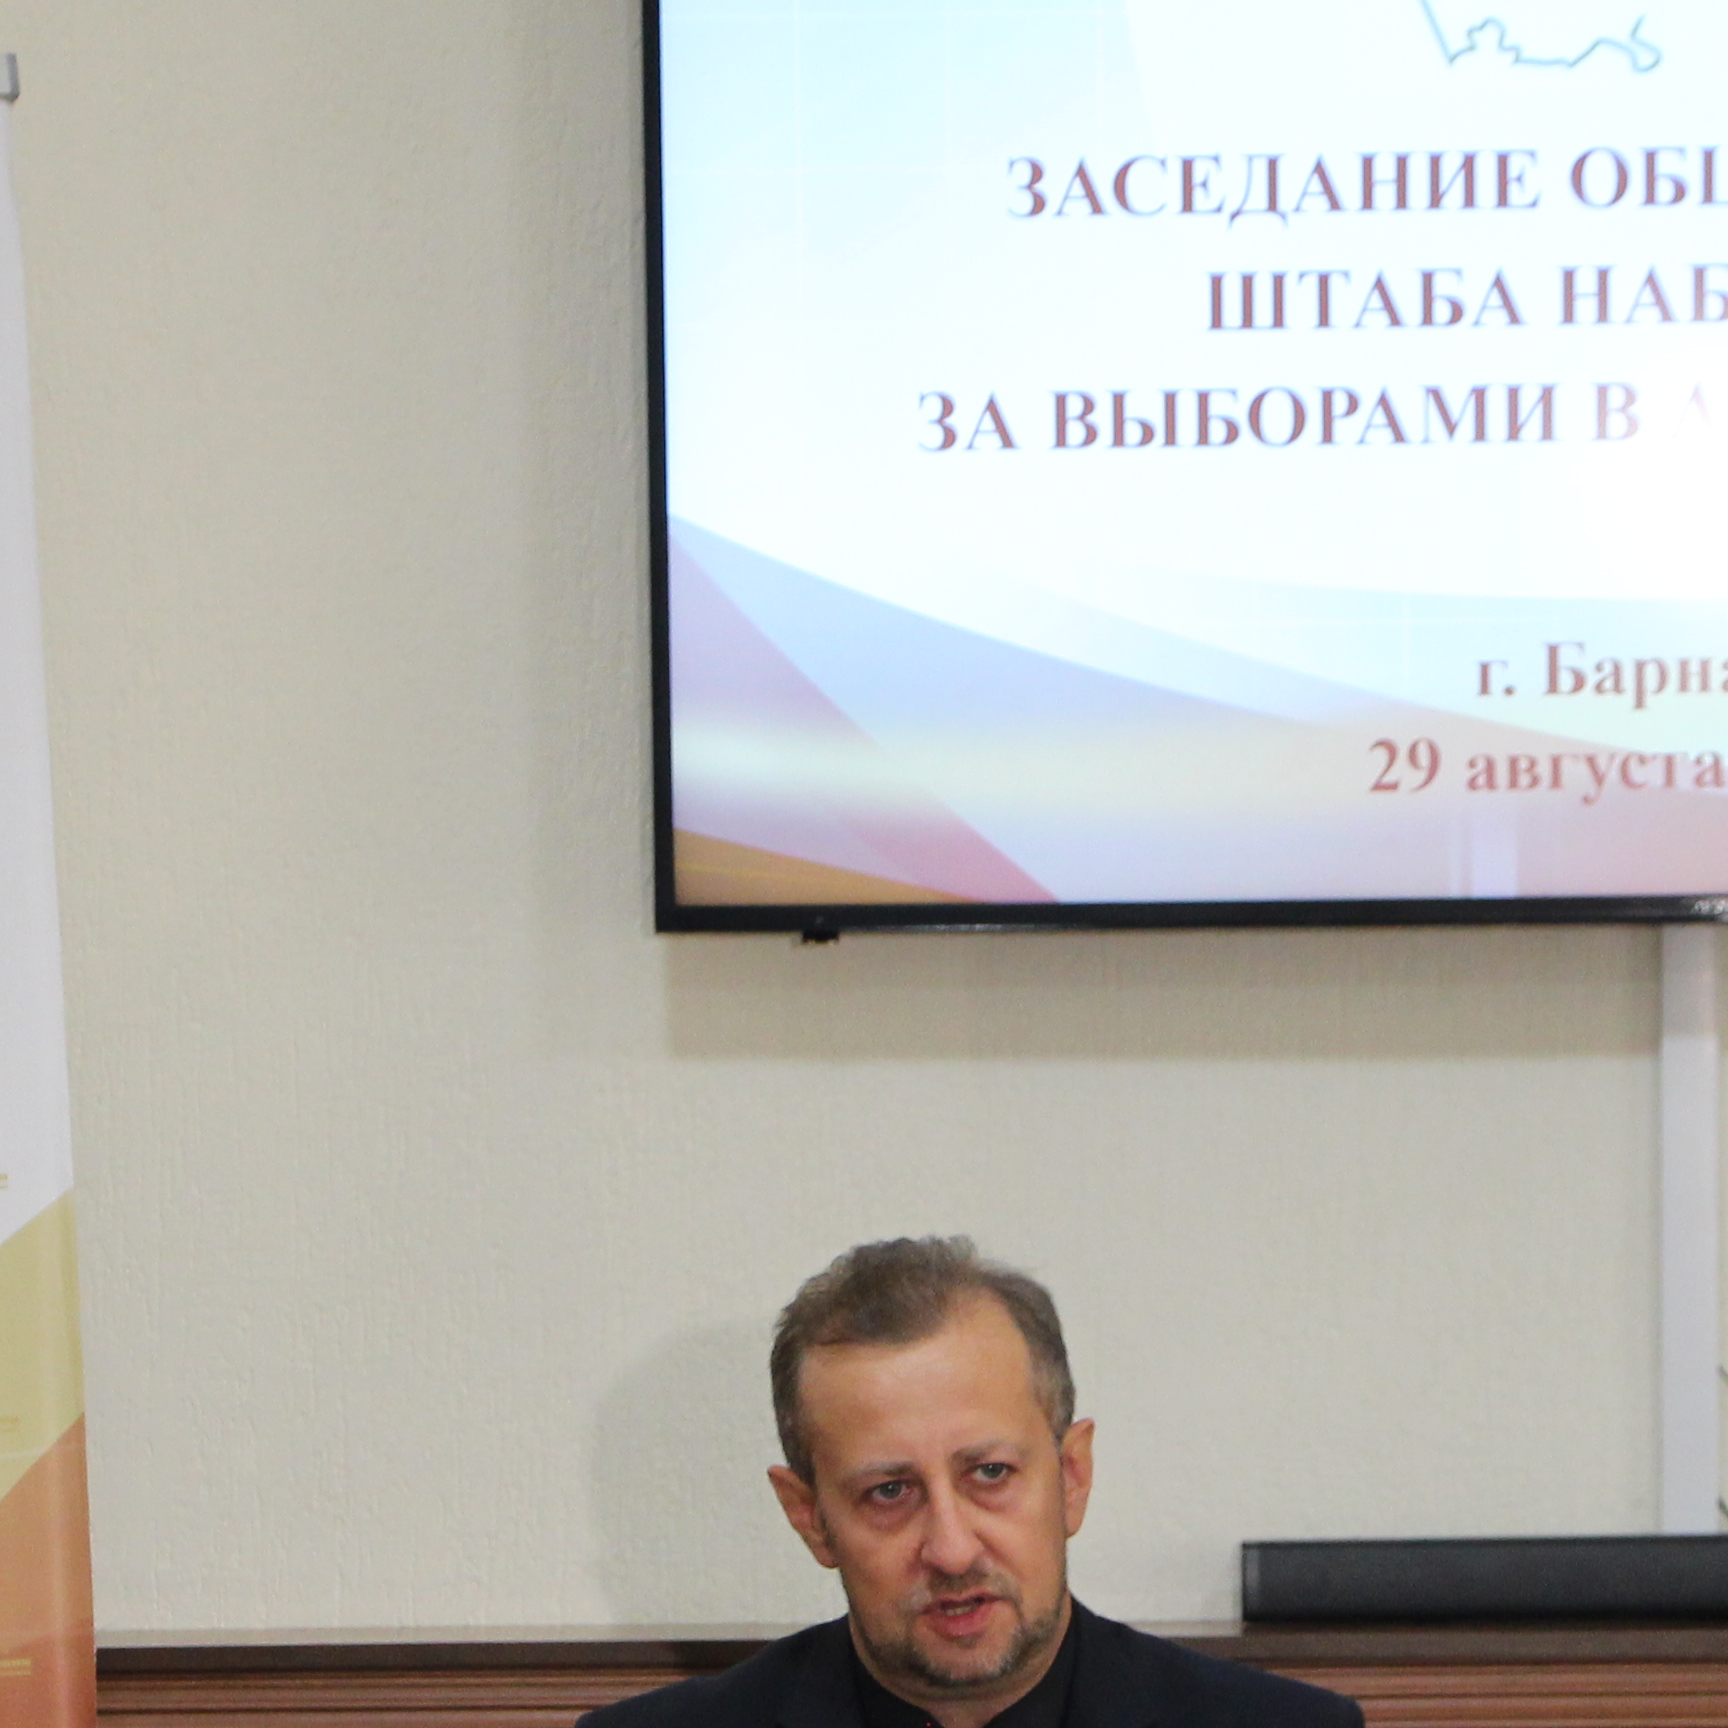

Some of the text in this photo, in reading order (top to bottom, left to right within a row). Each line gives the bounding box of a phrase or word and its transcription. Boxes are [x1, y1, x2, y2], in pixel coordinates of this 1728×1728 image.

[1007, 149, 1541, 229] ЗАСЕДАНИЕ
[1207, 267, 1526, 331] ШТАБА
[918, 390, 1021, 452] ЗА
[1050, 382, 1558, 450] ВЫБОРАМИ
[1593, 381, 1640, 441] В
[1475, 659, 1516, 697] г.
[1368, 736, 1443, 793] 29
[1465, 750, 1726, 805] августа
